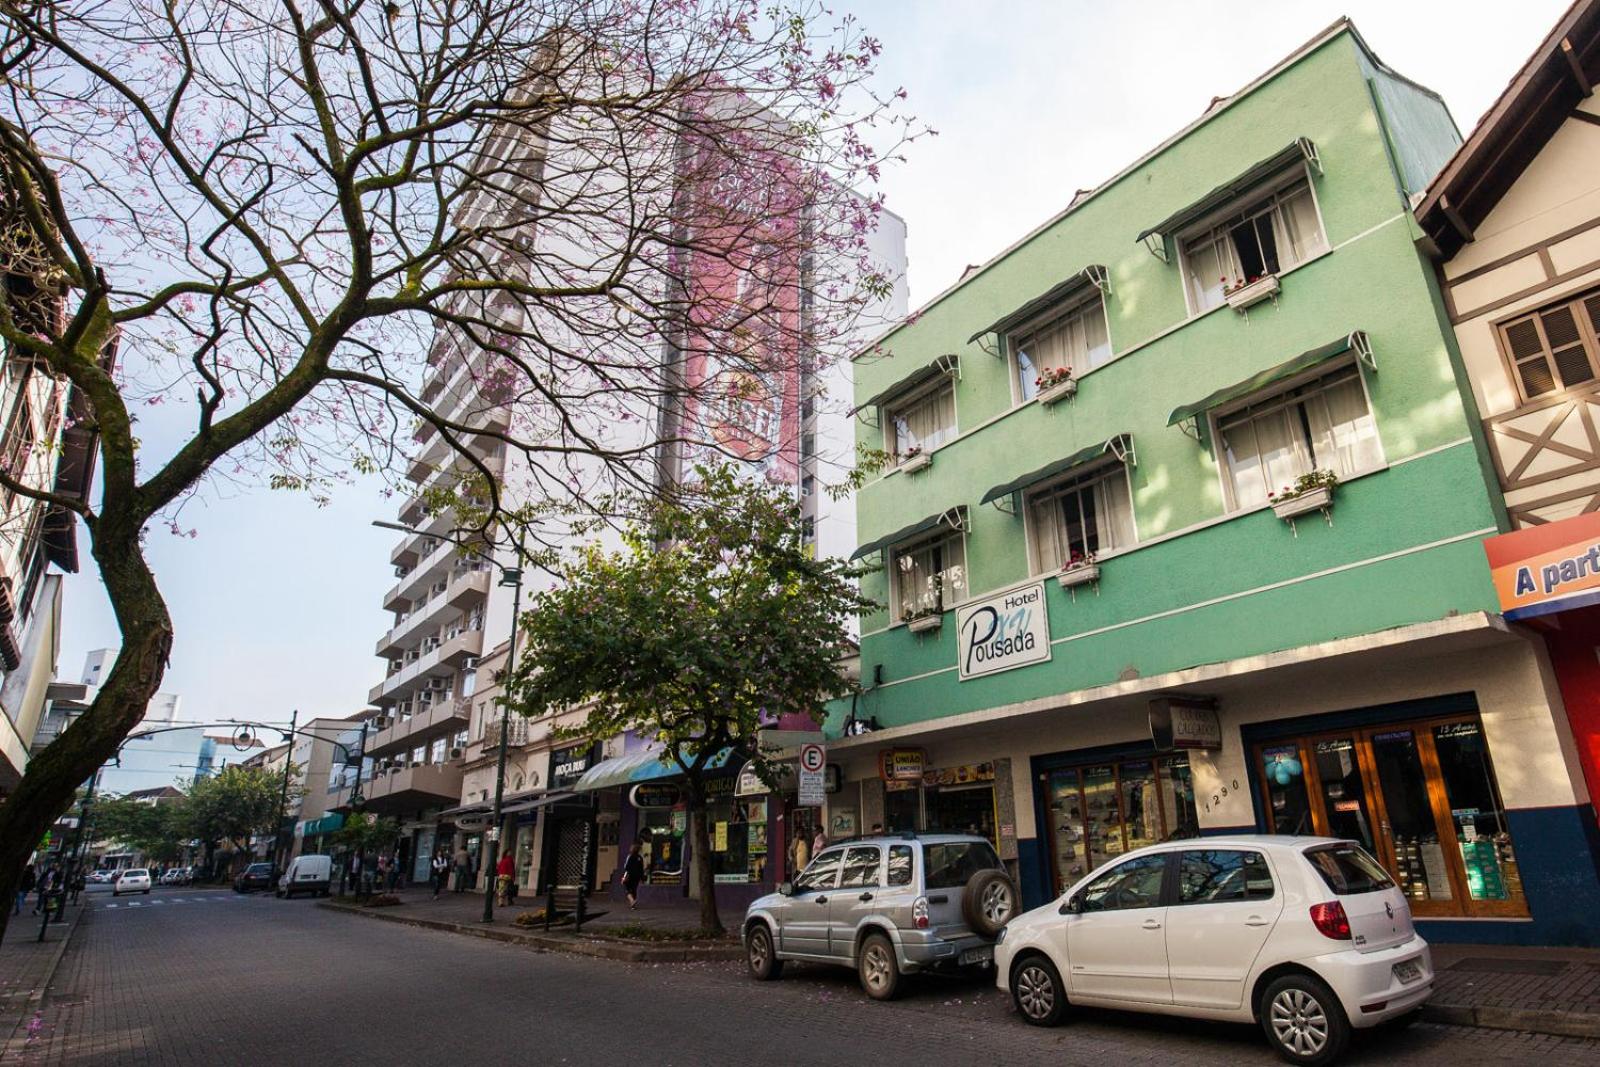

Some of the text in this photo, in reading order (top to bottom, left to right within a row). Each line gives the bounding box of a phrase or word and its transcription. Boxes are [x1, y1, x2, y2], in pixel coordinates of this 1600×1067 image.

[1517, 545, 1600, 596] A part
[1005, 588, 1039, 610] Hotel
[961, 605, 1035, 674] Pousada
[555, 763, 572, 776] MOÇA
[807, 750, 818, 766] E
[1205, 779, 1239, 813] 1290
